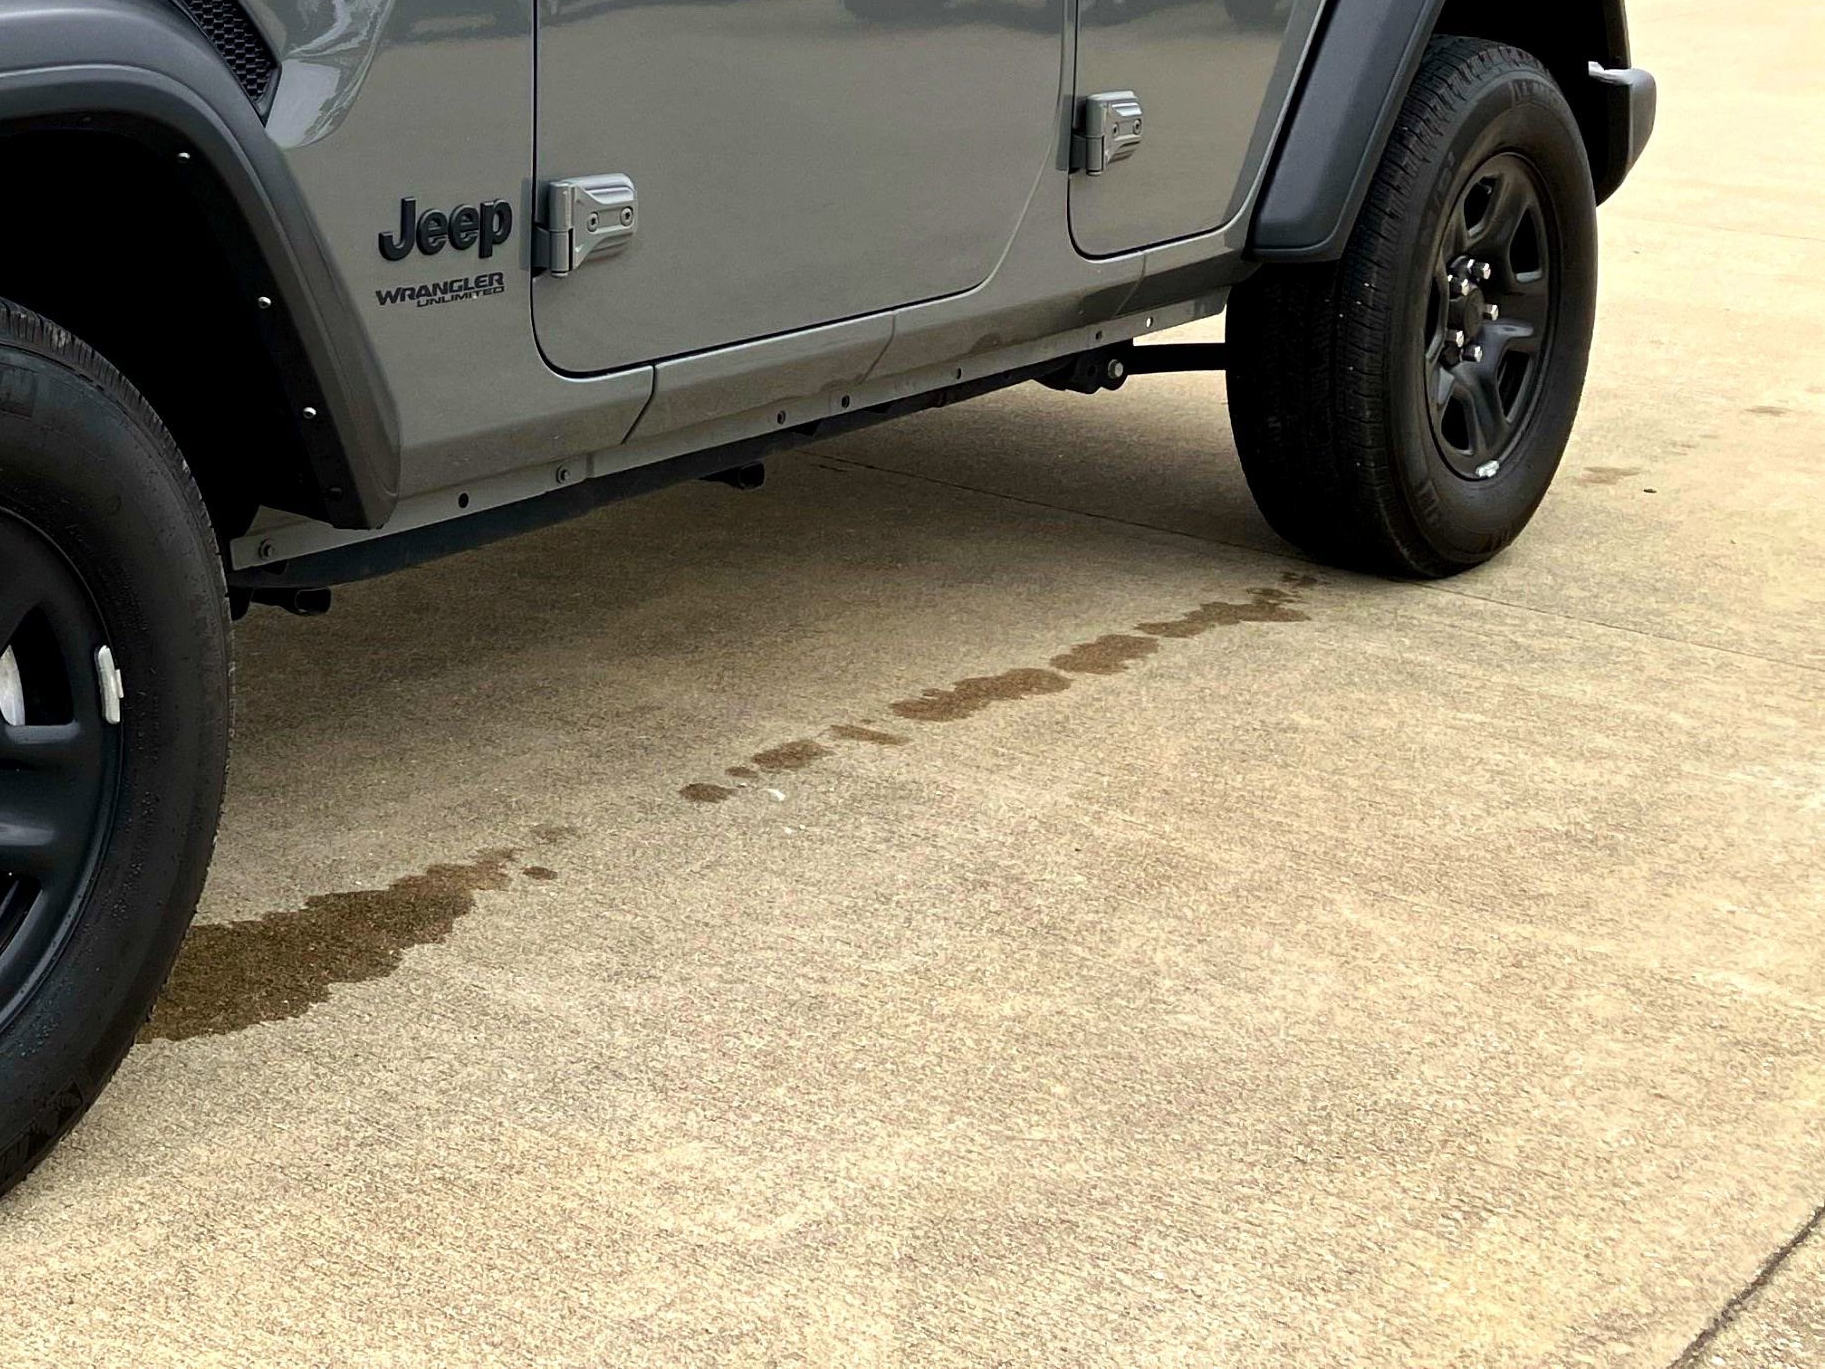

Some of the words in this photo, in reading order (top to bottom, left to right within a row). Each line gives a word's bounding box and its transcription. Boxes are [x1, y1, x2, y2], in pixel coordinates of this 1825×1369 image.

[378, 196, 513, 261] Jeep
[375, 271, 504, 306] WRANGLER
[416, 285, 505, 308] UNLIMITED
